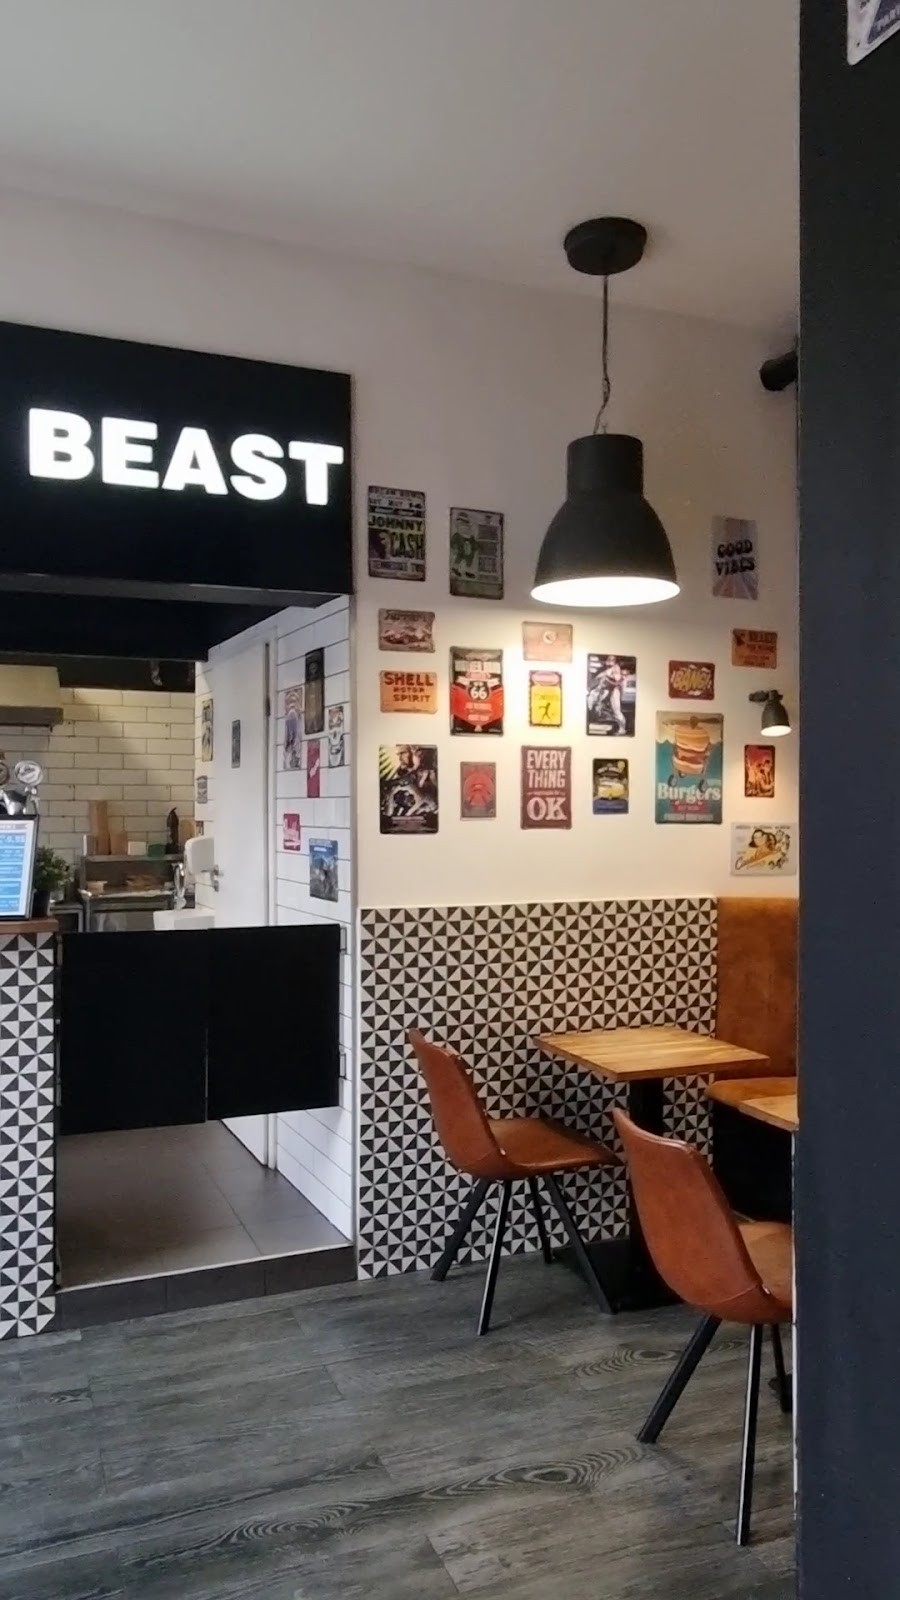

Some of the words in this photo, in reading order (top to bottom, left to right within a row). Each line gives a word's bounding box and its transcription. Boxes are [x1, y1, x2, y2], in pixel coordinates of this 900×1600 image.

[29, 407, 344, 506] BEAST
[368, 515, 423, 532] JOHNNY
[390, 532, 425, 560] CASH
[717, 539, 753, 558] GOOD
[715, 557, 755, 576] VIBES
[383, 672, 434, 687] SHELL
[393, 694, 431, 703] SPIRIT
[470, 686, 488, 700] 66
[526, 749, 567, 769] EVERY
[657, 782, 721, 804] Burgers
[526, 796, 568, 821] OK
